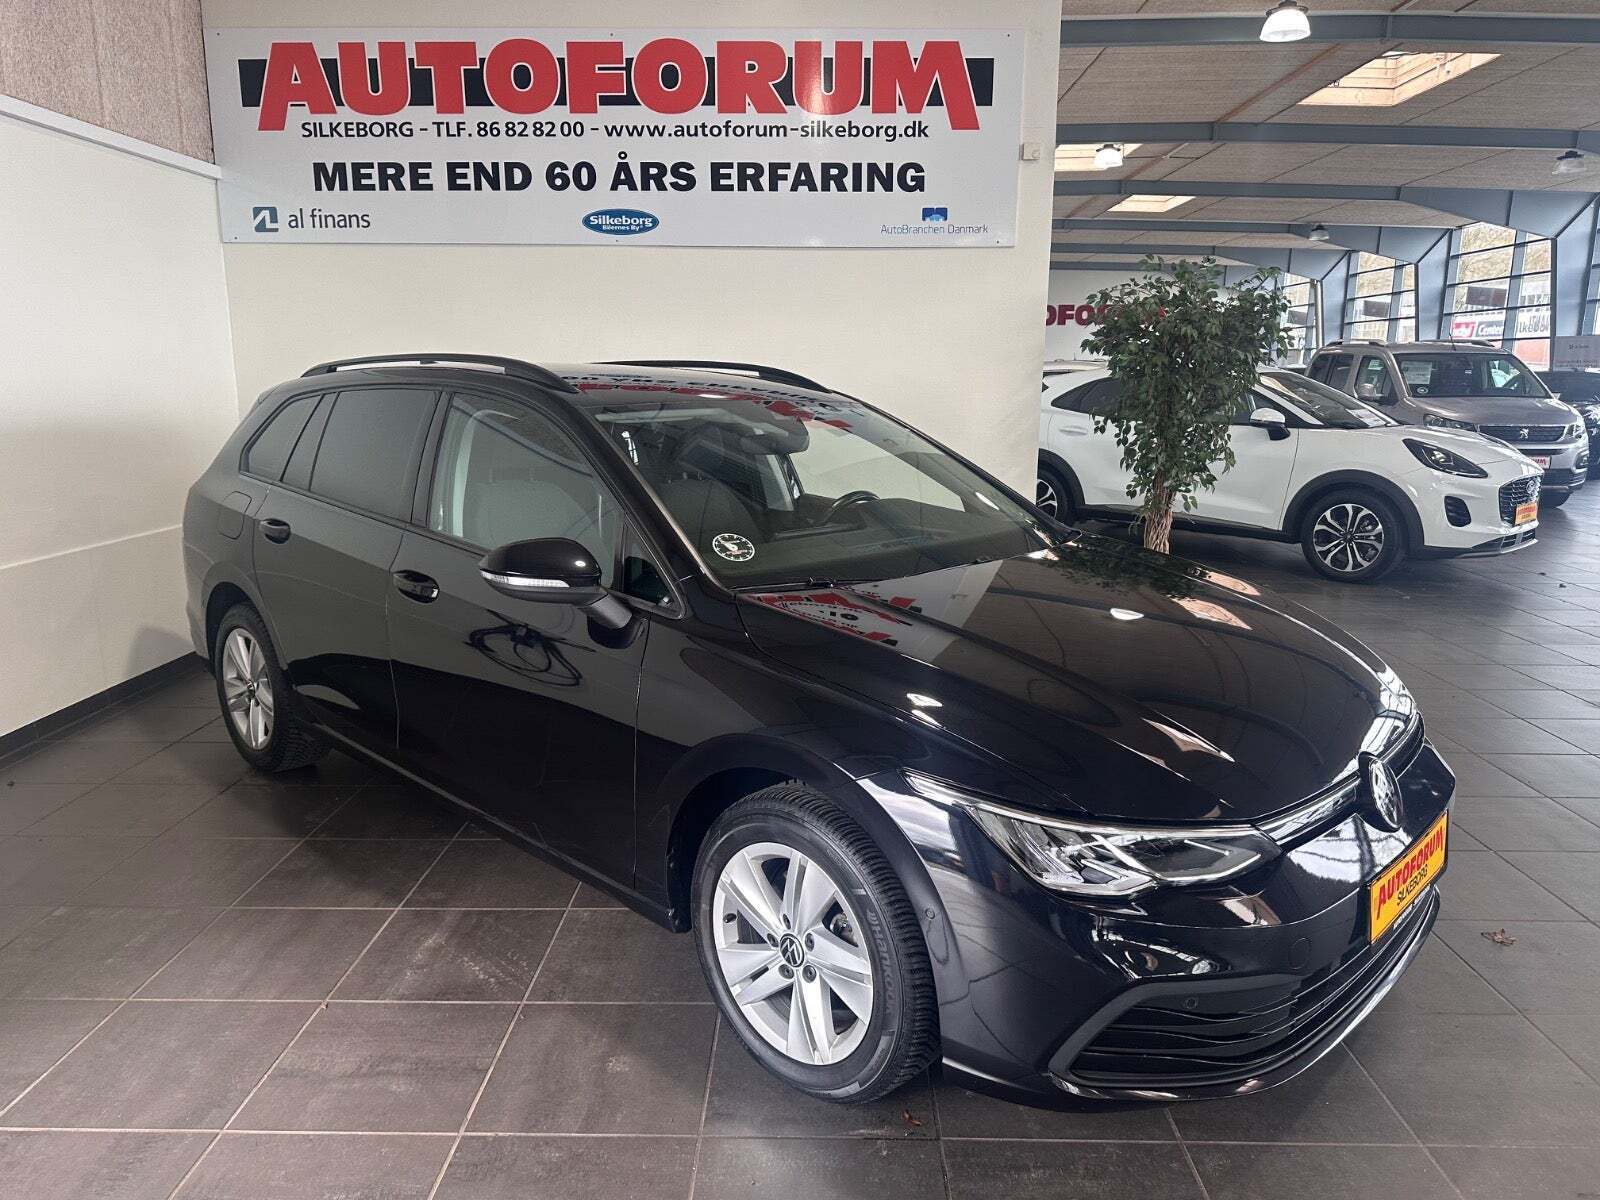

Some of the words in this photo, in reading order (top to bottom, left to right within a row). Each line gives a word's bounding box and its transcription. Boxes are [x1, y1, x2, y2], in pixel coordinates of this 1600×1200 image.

[258, 37, 981, 131] AUTOFORUM
[301, 121, 414, 138] SILKEBORG
[432, 121, 473, 138] TLF.
[477, 121, 501, 138] 86
[505, 121, 529, 138] 82
[533, 121, 557, 138] 82
[560, 121, 585, 138] 00
[604, 120, 929, 143] www.autoforum-silkeborg.dk
[312, 161, 434, 192] MERE
[447, 161, 532, 192] END
[545, 161, 597, 192] 60
[609, 150, 697, 192] ÅRS
[710, 161, 925, 193] ERFARING
[287, 208, 305, 229] al
[310, 208, 371, 229] finans
[589, 215, 653, 227] Silkeborg
[880, 224, 945, 235] AutoBranchen
[947, 223, 989, 235] Danmark
[1376, 826, 1444, 920] AUTOFORUM
[1396, 864, 1428, 906] SILKEBORG
